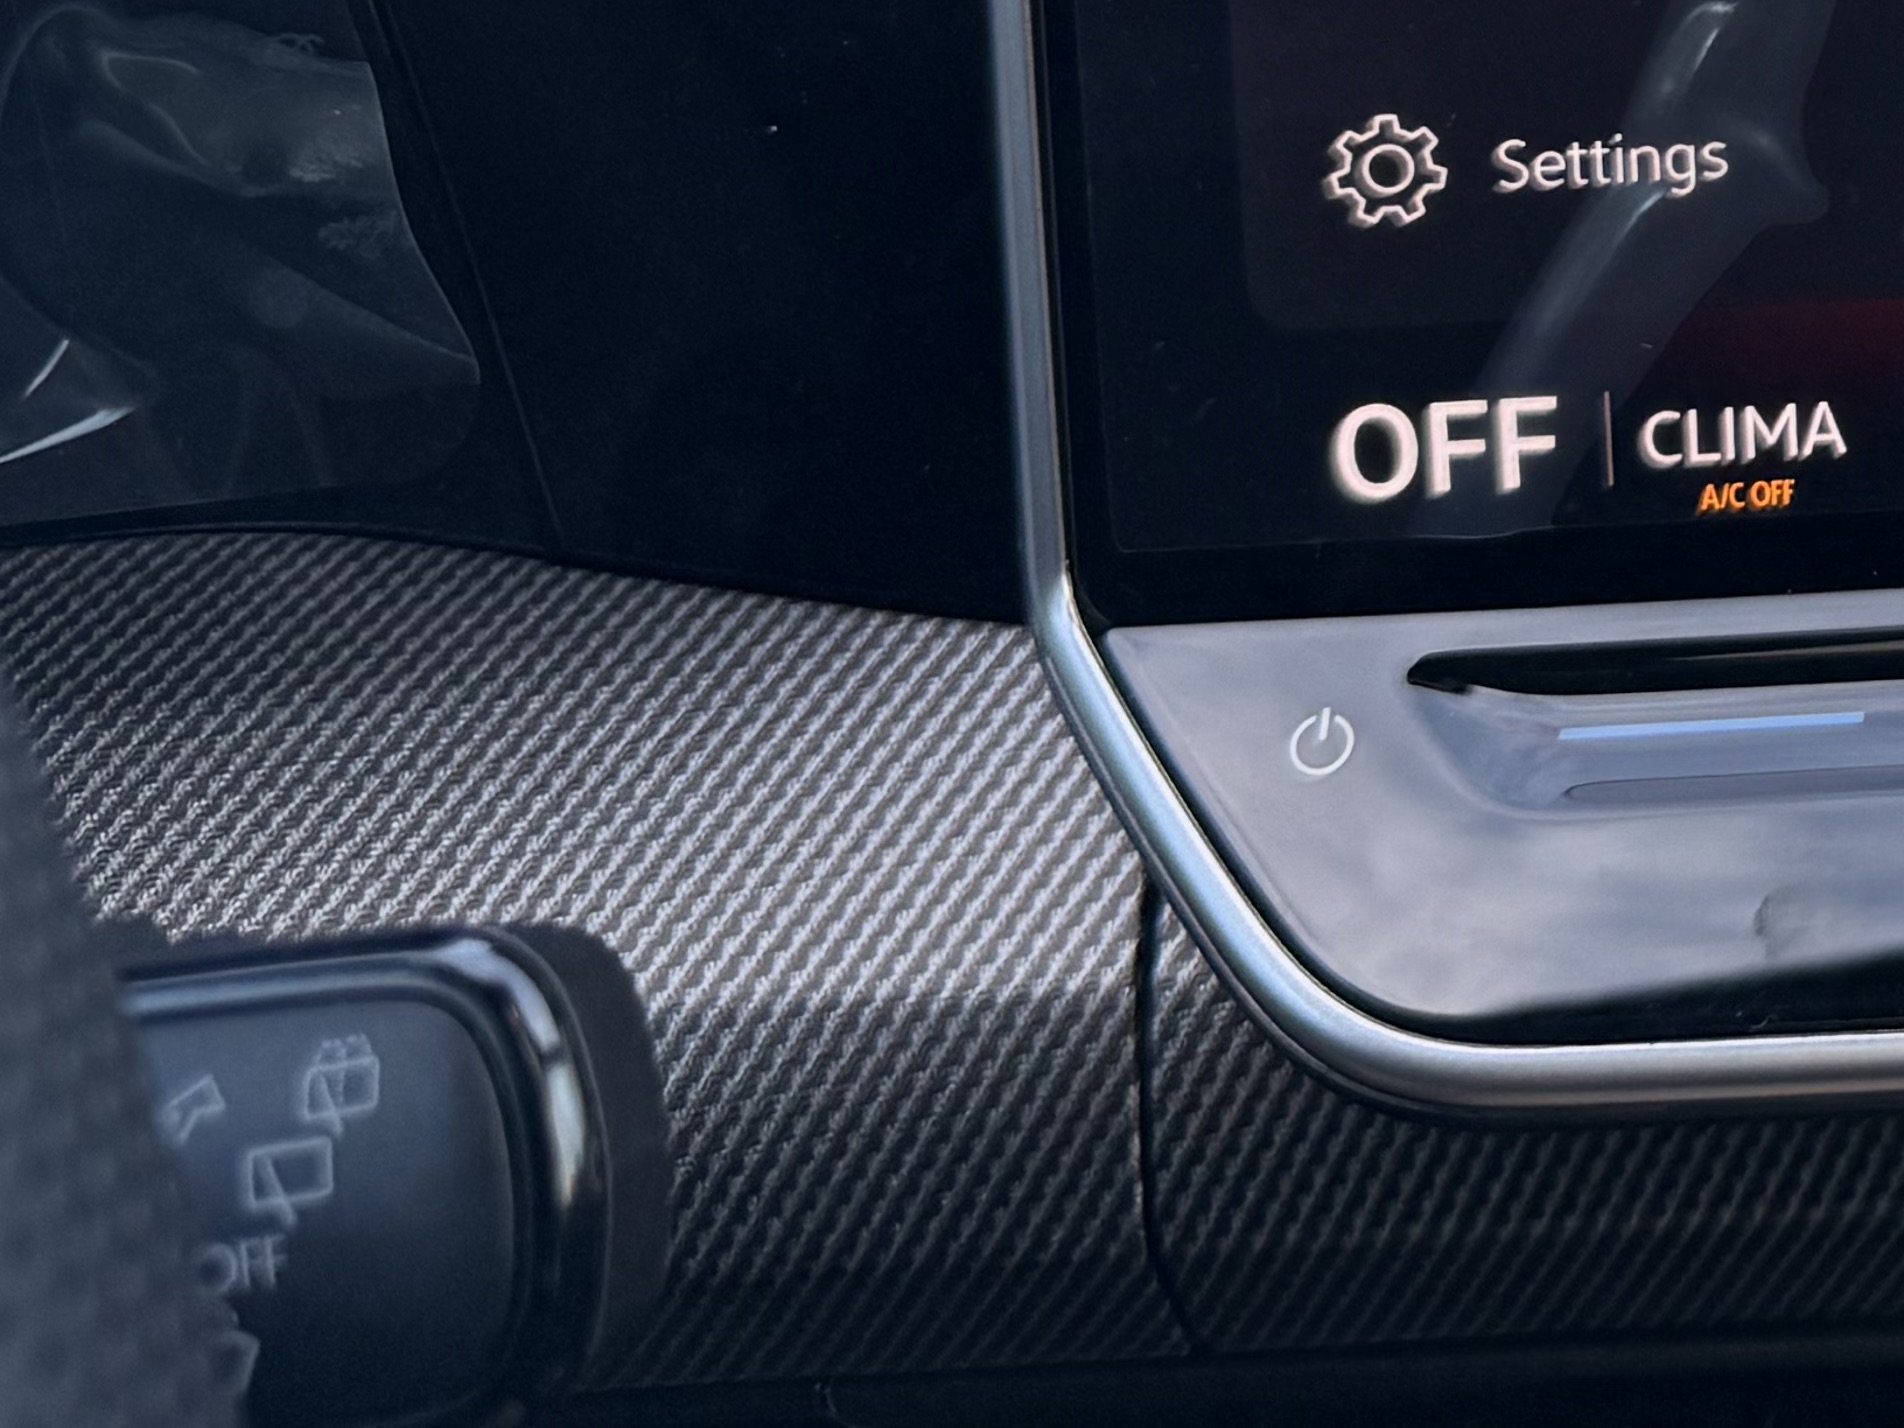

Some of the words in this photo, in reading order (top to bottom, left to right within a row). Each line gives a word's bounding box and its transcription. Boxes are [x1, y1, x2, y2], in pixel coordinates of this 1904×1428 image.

[1497, 134, 1728, 198] Settings
[1335, 396, 1557, 500] OFF
[1642, 402, 1846, 466] CLIMA
[1700, 483, 1745, 510] A/C
[1750, 480, 1794, 508] OFF
